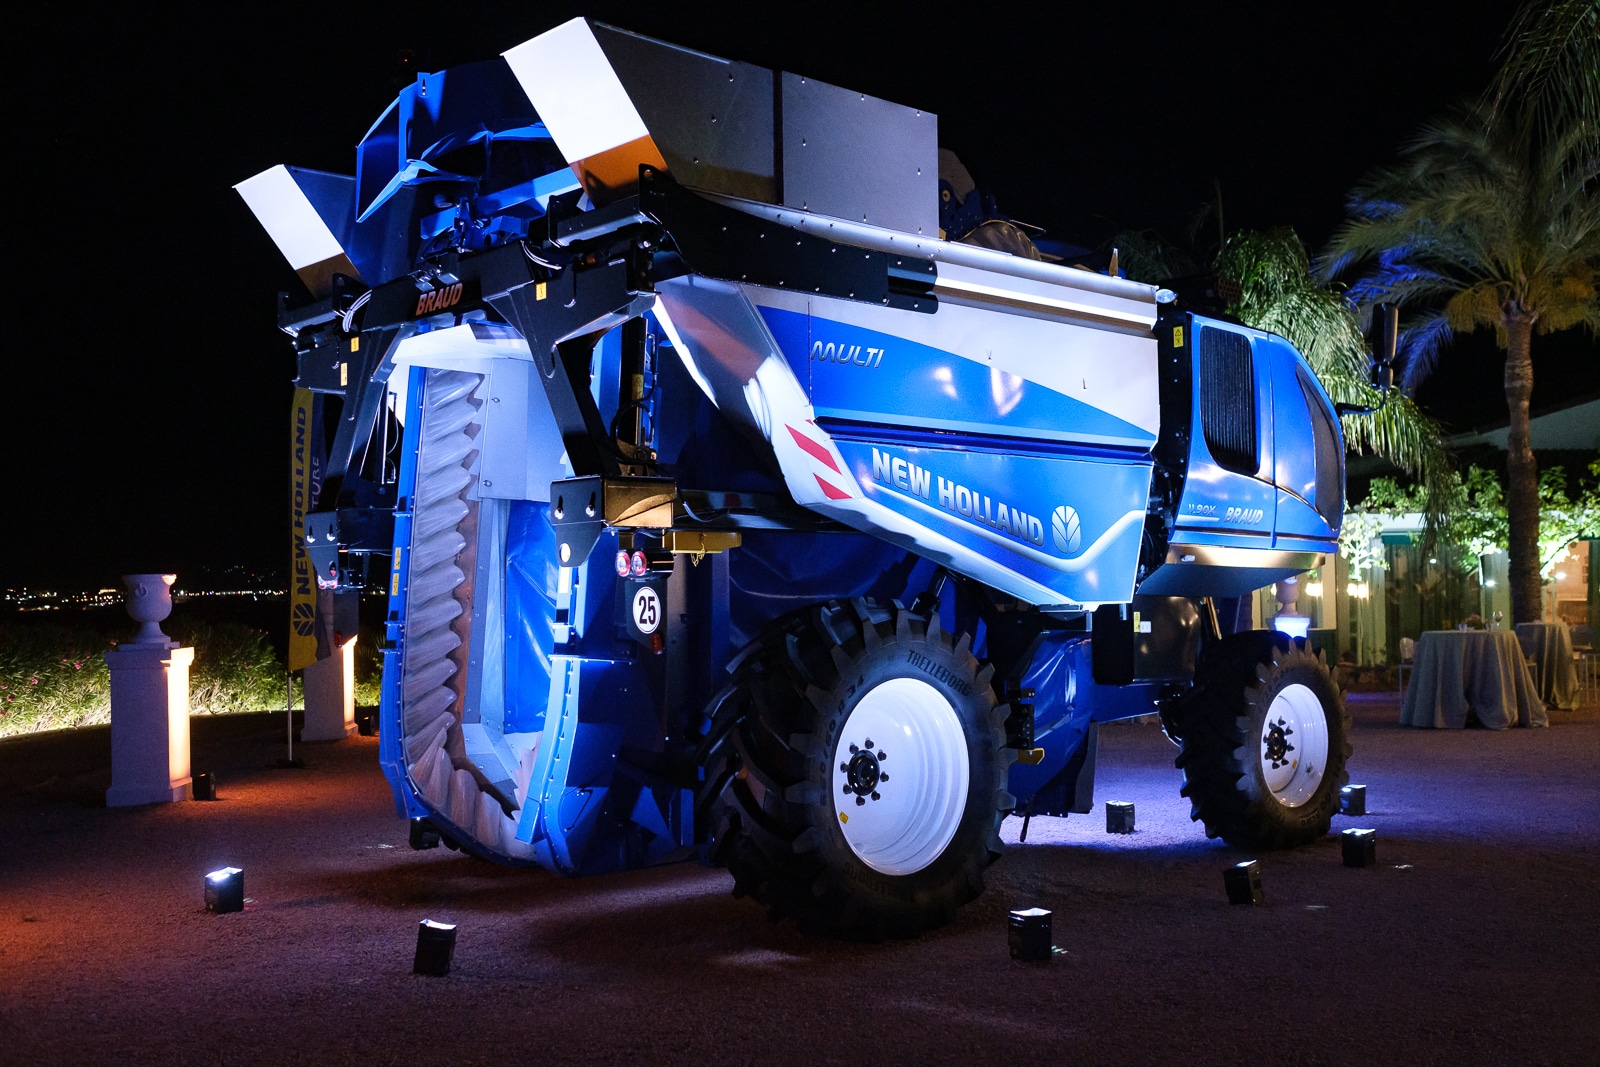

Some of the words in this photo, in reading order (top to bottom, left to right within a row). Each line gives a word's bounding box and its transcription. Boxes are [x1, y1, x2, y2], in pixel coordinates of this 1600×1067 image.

[415, 282, 463, 316] BRAUD
[810, 340, 885, 369] MULTI
[294, 406, 307, 529] HOLLAND
[311, 456, 322, 508] TURE
[872, 447, 931, 500] NEW
[937, 475, 1044, 547] HOLLAND
[1224, 506, 1264, 525] BRAUD
[294, 533, 311, 595] NEW
[638, 595, 657, 625] 25
[906, 649, 972, 697] TRELLEBORG
